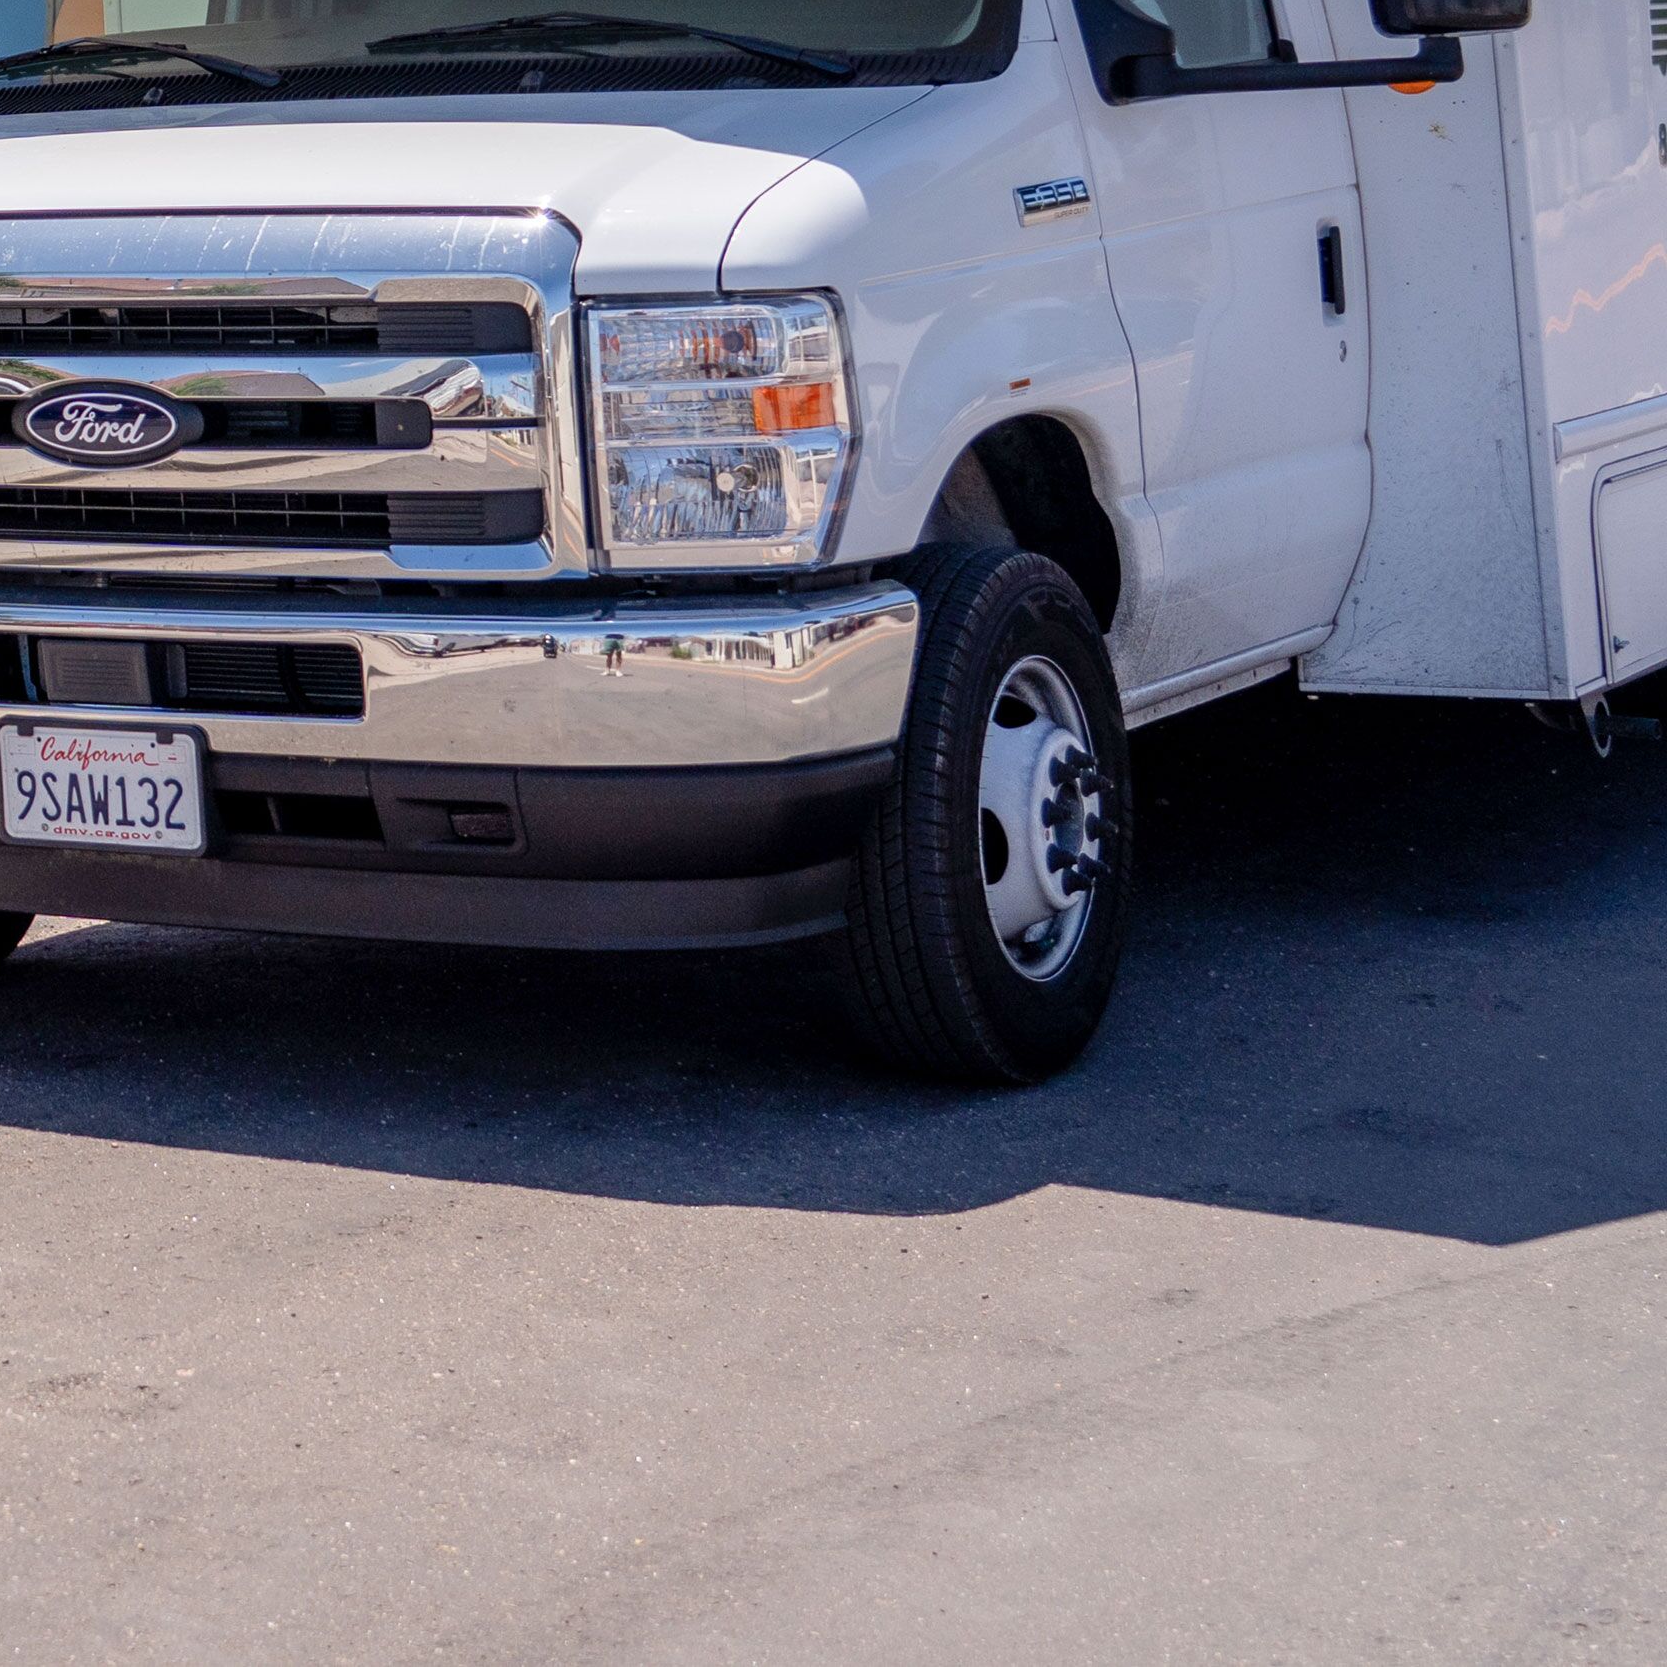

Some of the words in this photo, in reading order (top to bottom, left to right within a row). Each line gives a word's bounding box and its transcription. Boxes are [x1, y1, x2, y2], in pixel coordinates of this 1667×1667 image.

[55, 401, 145, 445] Ford
[40, 736, 159, 770] California
[17, 770, 186, 830] 9SAW132
[53, 825, 151, 840] dmv.ca.gov
